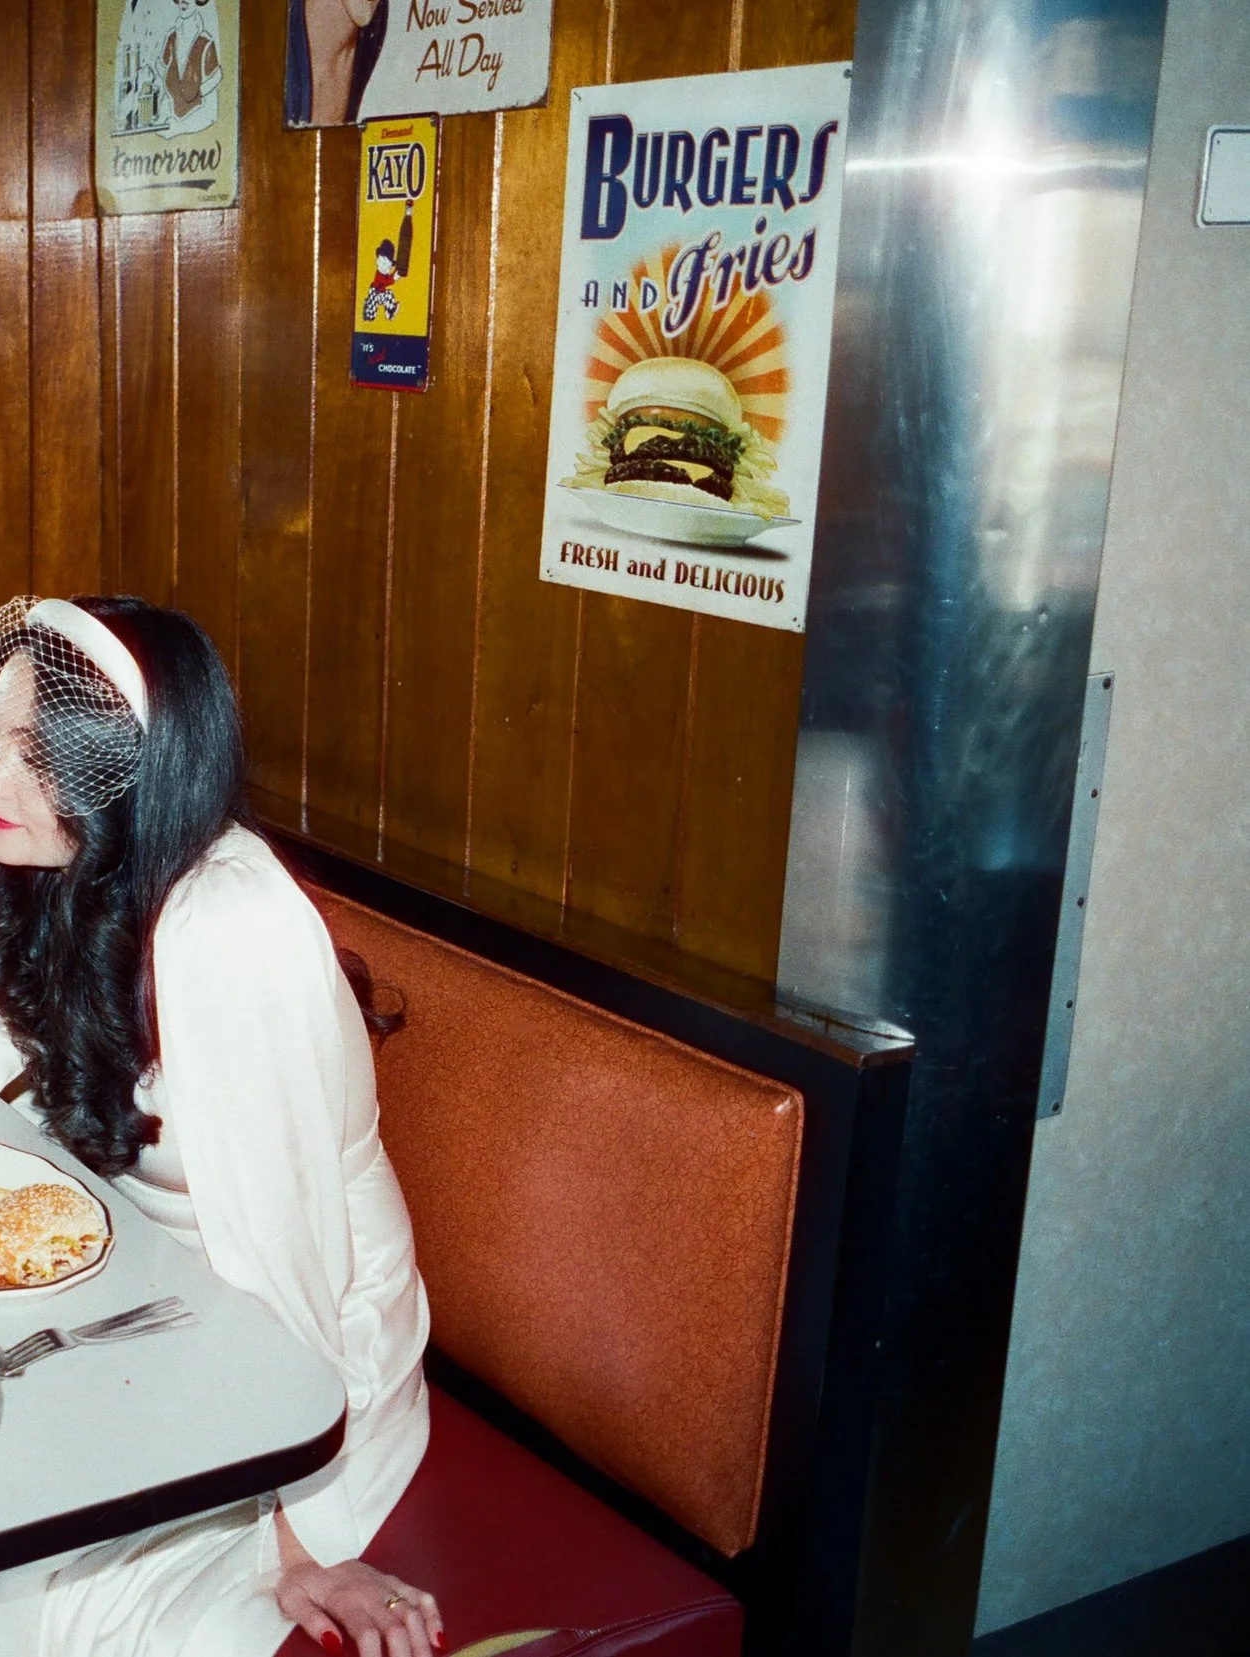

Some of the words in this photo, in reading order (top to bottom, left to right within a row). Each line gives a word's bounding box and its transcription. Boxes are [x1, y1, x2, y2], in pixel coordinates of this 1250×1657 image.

[406, 0, 451, 32] Now
[415, 38, 455, 82] All
[458, 33, 502, 91] Day
[112, 139, 222, 178] tomorrow
[367, 142, 425, 200] KAYO
[580, 114, 838, 240] BURGERS
[581, 280, 659, 311] AND
[662, 216, 817, 334] Fries
[560, 541, 619, 572] FRESH
[627, 558, 666, 581] and
[674, 560, 785, 604] DELICIOUS
